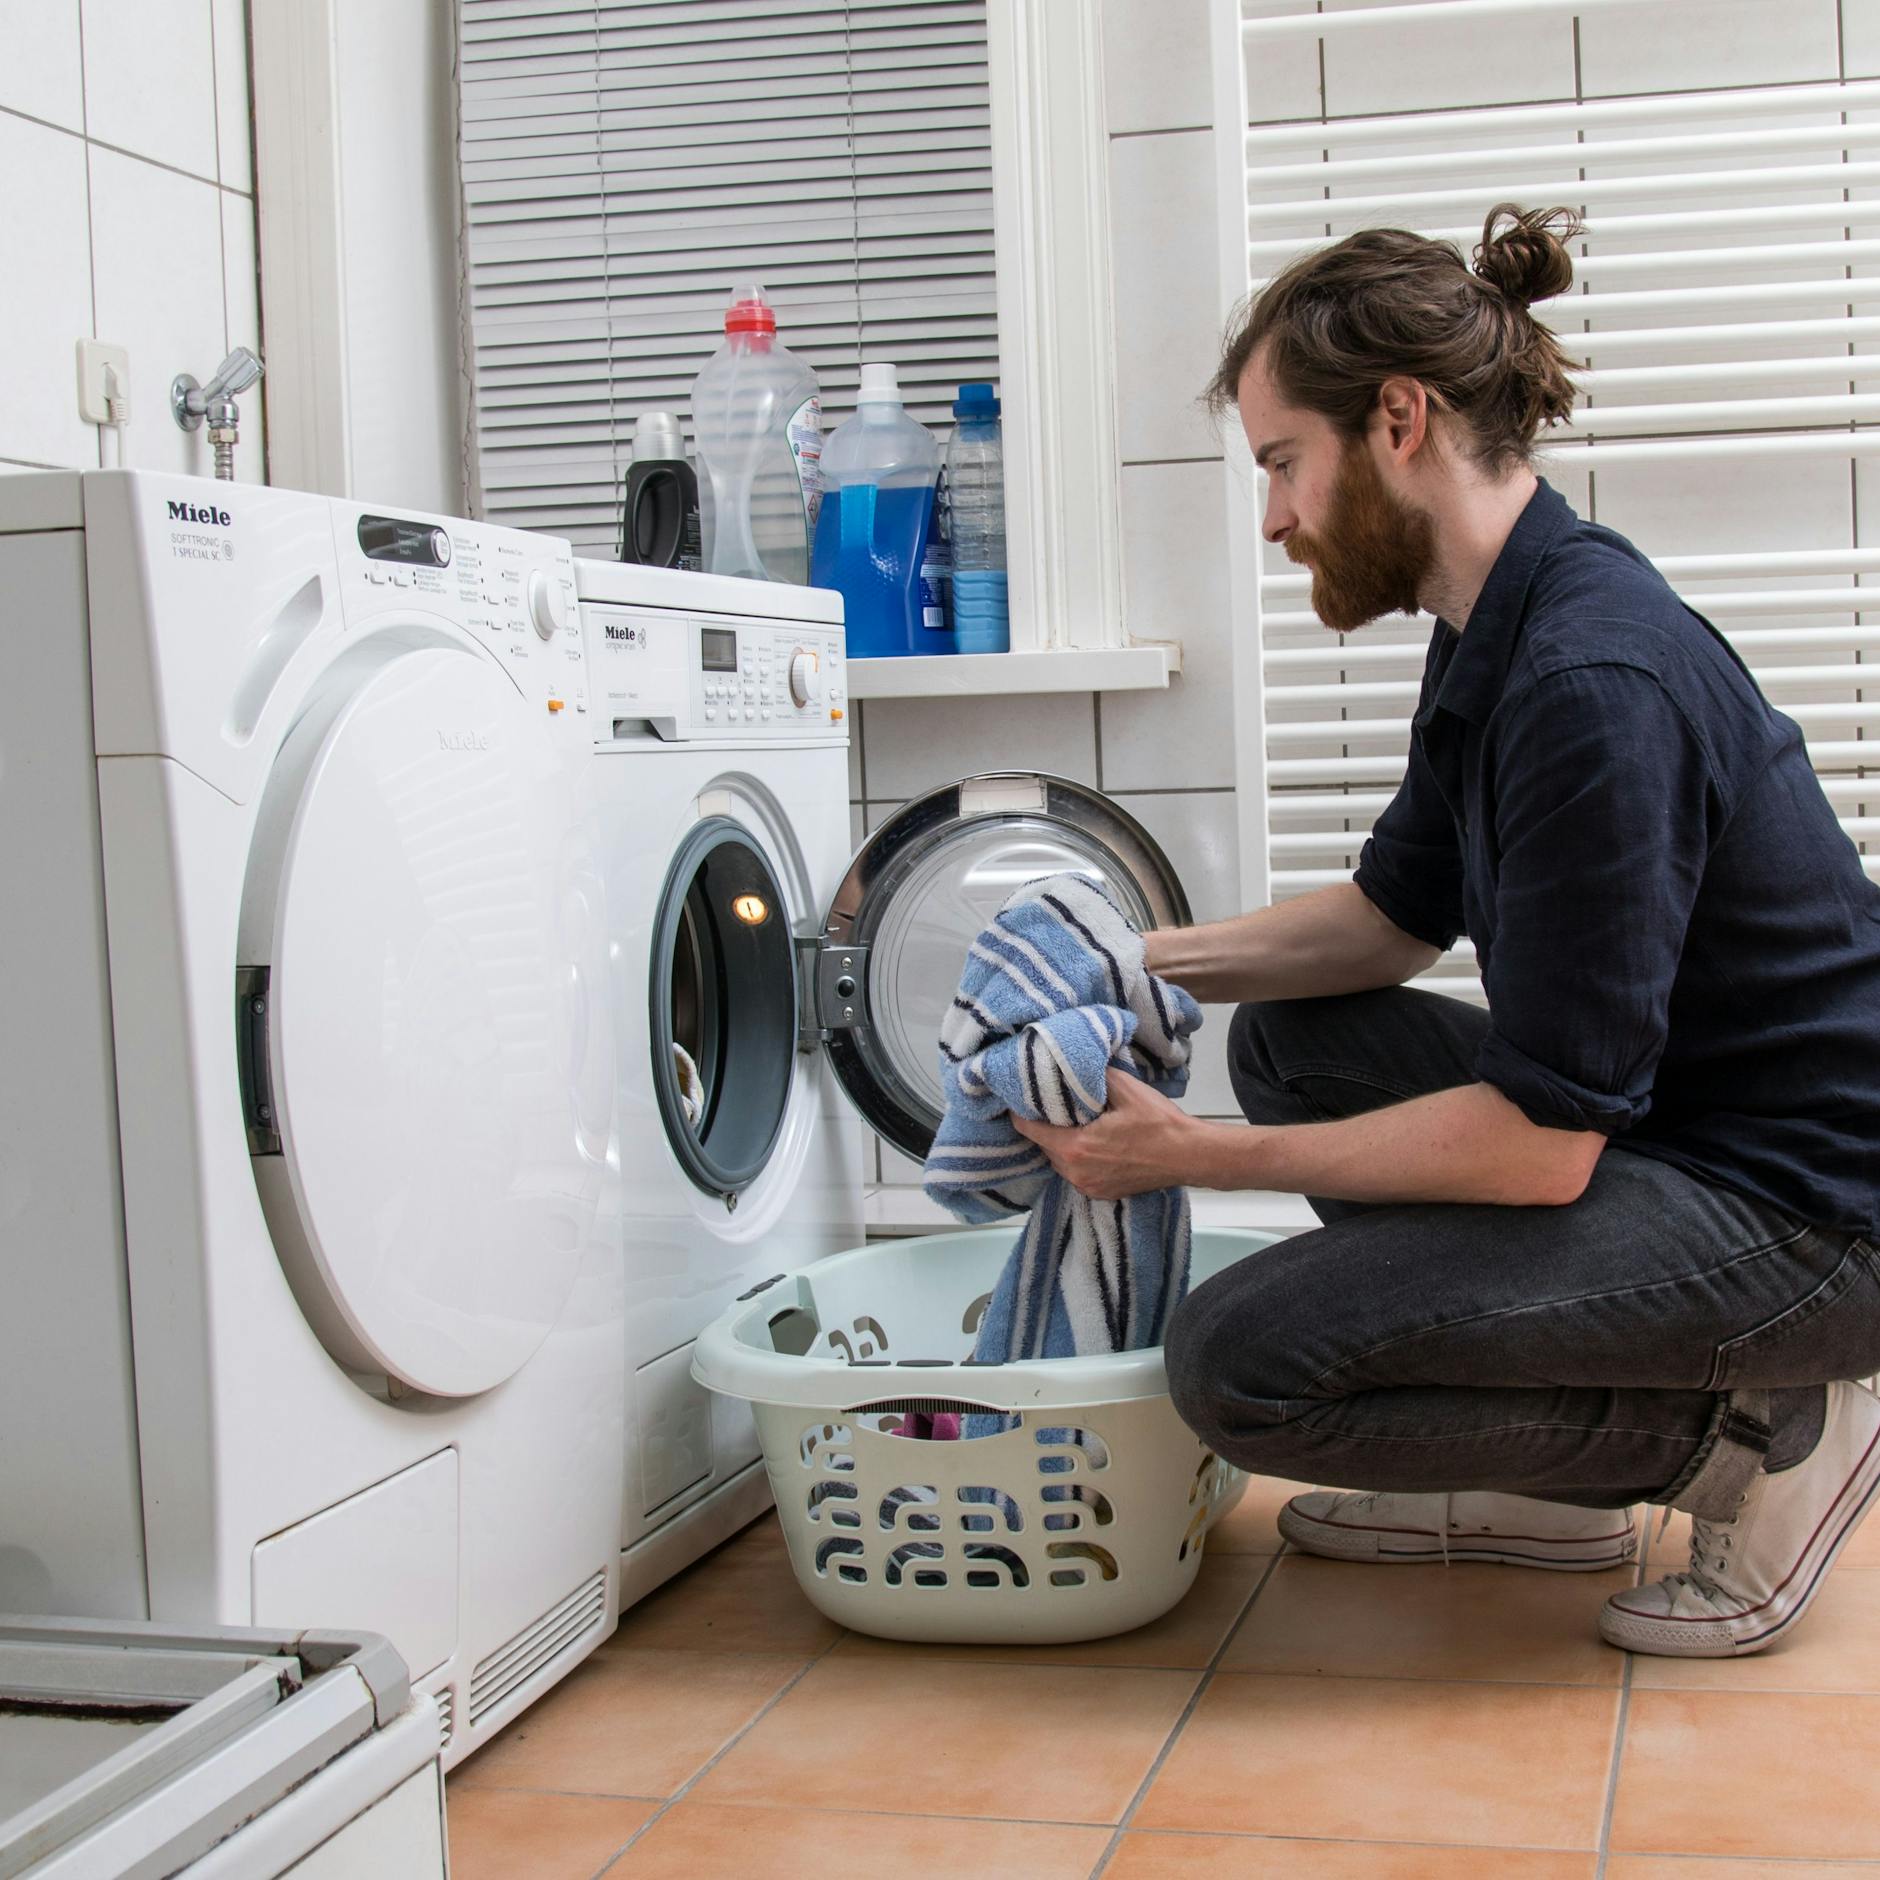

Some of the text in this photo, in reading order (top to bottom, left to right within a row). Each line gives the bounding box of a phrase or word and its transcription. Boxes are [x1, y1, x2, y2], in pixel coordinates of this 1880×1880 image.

[167, 500, 231, 527] Miele
[170, 532, 220, 547] SOFTTRONIC
[178, 547, 209, 560] SPECIAL
[605, 625, 636, 641] Miele
[436, 729, 489, 752] Miele
